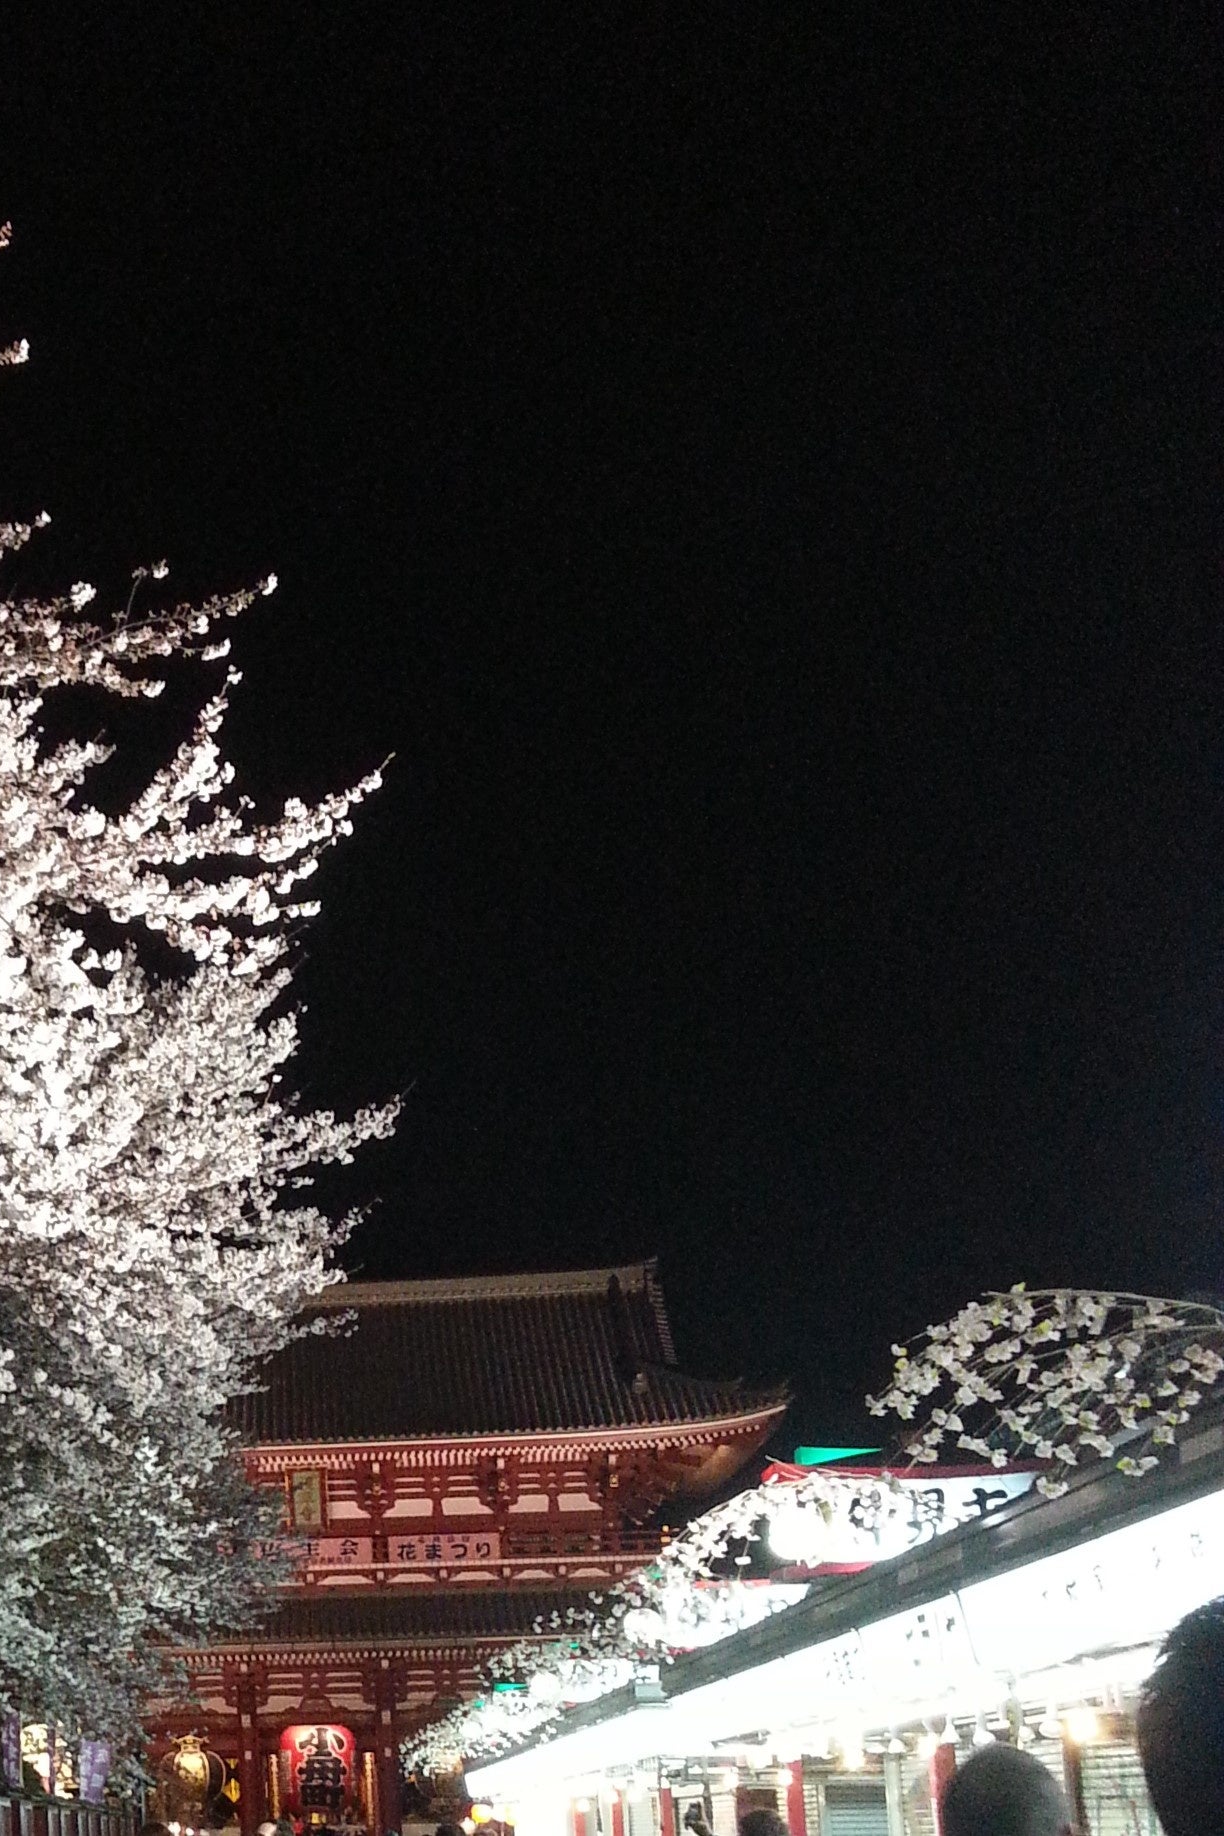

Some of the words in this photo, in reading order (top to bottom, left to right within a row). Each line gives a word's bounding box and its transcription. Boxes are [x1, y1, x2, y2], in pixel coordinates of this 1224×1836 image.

[396, 1542, 491, 1560] 花まつり
[297, 1727, 347, 1809] 小舟町
